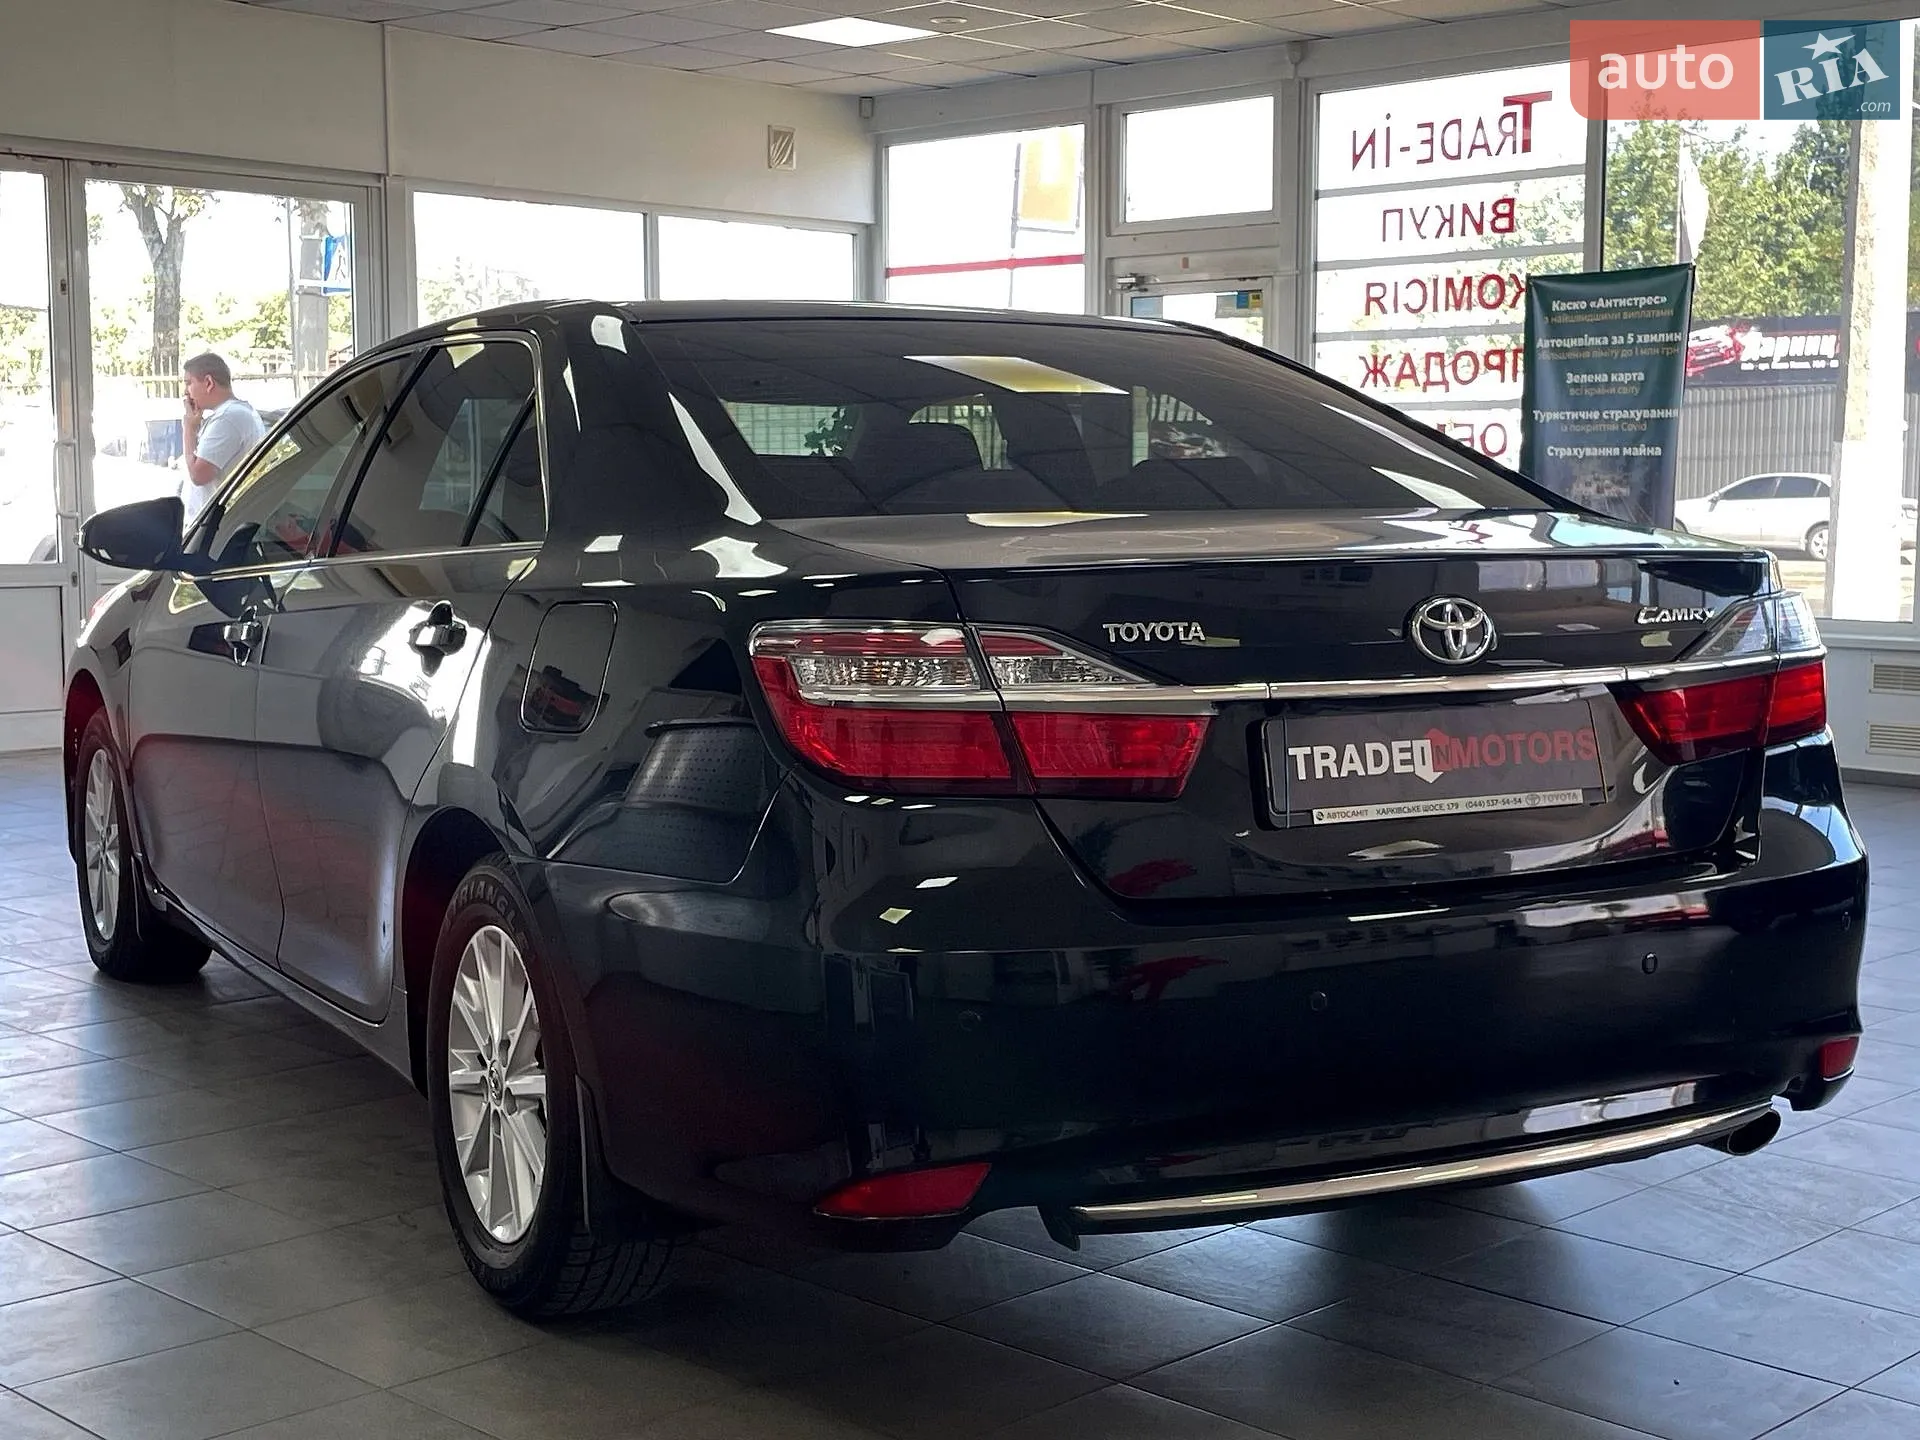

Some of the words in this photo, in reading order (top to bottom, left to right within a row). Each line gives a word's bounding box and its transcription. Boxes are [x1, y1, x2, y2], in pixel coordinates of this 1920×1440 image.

[1551, 300, 1588, 312] Каско
[1536, 334, 1609, 349] Автоцивілка
[1611, 335, 1624, 346] за
[1626, 333, 1636, 345] 5
[1636, 331, 1682, 343] хвилин
[1566, 372, 1608, 384] Зелена
[1610, 371, 1645, 384] карта
[1532, 409, 1600, 423] Туристичне
[1602, 407, 1679, 422] страхування
[1546, 445, 1620, 458] Страхування
[1622, 443, 1662, 456] майна
[1636, 606, 1716, 624] CAMRY
[1102, 621, 1206, 643] TOYOTA
[1287, 740, 1415, 781] TRADE
[1451, 727, 1598, 769] MOTORS
[1541, 791, 1578, 803] TOYOTA
